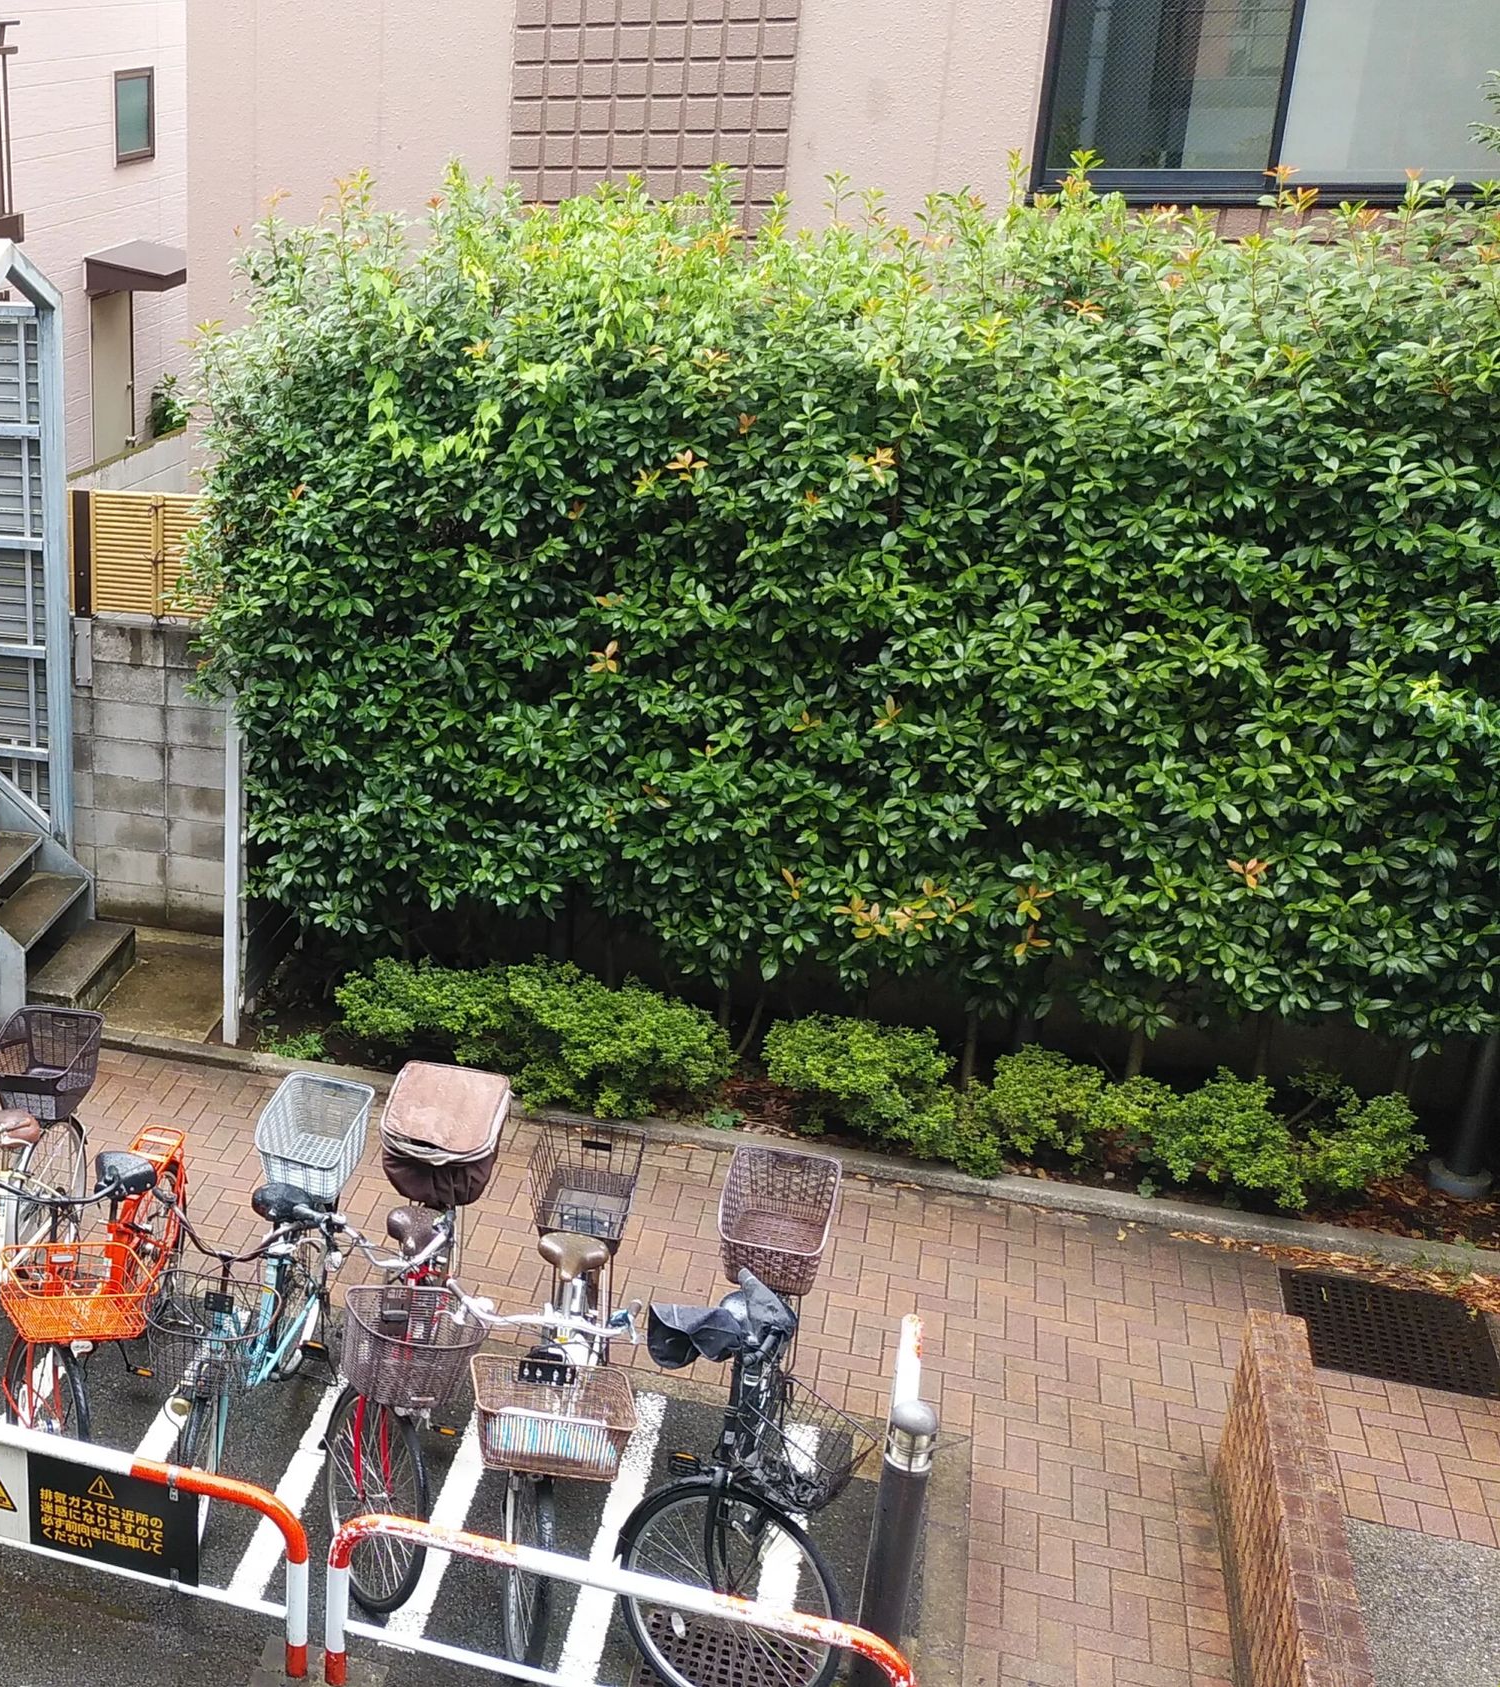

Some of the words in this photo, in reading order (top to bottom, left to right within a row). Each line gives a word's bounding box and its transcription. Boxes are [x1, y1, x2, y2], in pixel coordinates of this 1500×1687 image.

[39, 1487, 164, 1529] 排気ガスでご近所の
[40, 1500, 164, 1543] 迷惑になりますので
[41, 1513, 164, 1555] 必ず前向きに駐車して
[42, 1527, 94, 1549] ください
